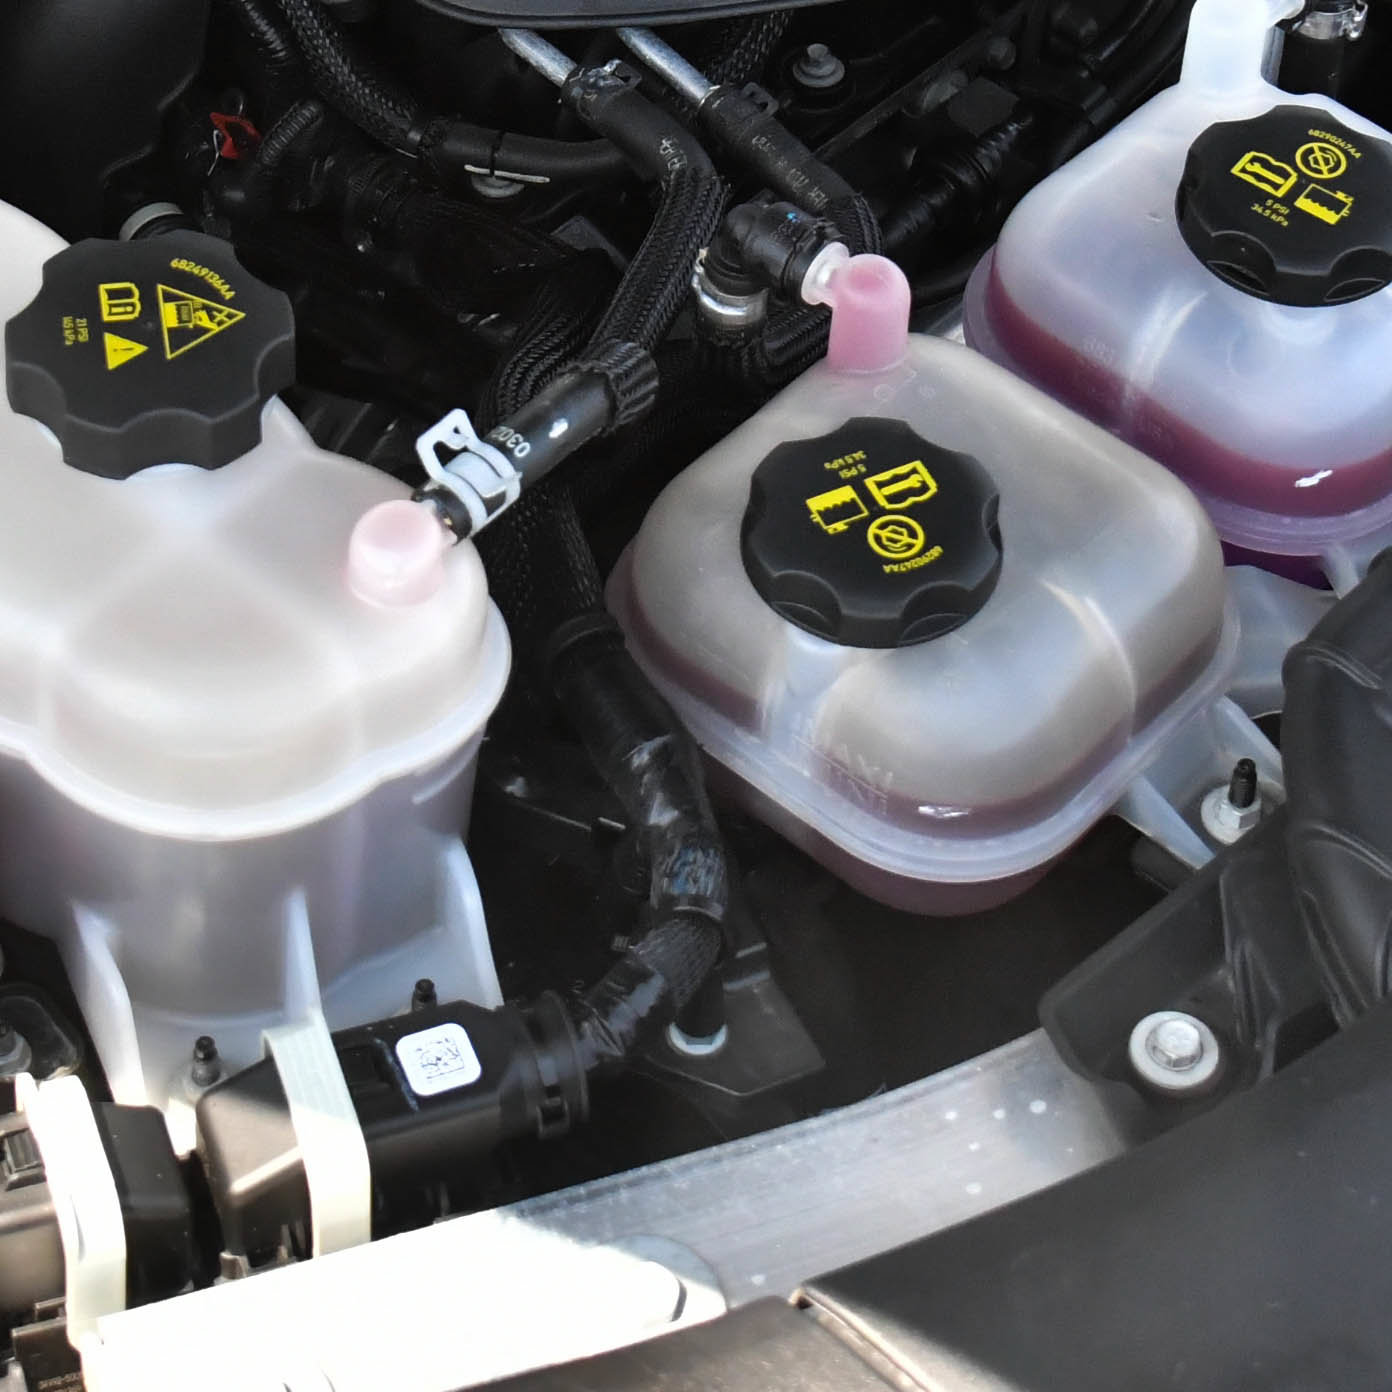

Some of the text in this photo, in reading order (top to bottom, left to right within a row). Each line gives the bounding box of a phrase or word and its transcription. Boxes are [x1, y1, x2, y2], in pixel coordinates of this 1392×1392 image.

[1272, 202, 1290, 215] PSI
[1270, 211, 1289, 227] kPa
[64, 328, 74, 345] kPa
[78, 327, 88, 342] PSI
[838, 468, 857, 479] PSI
